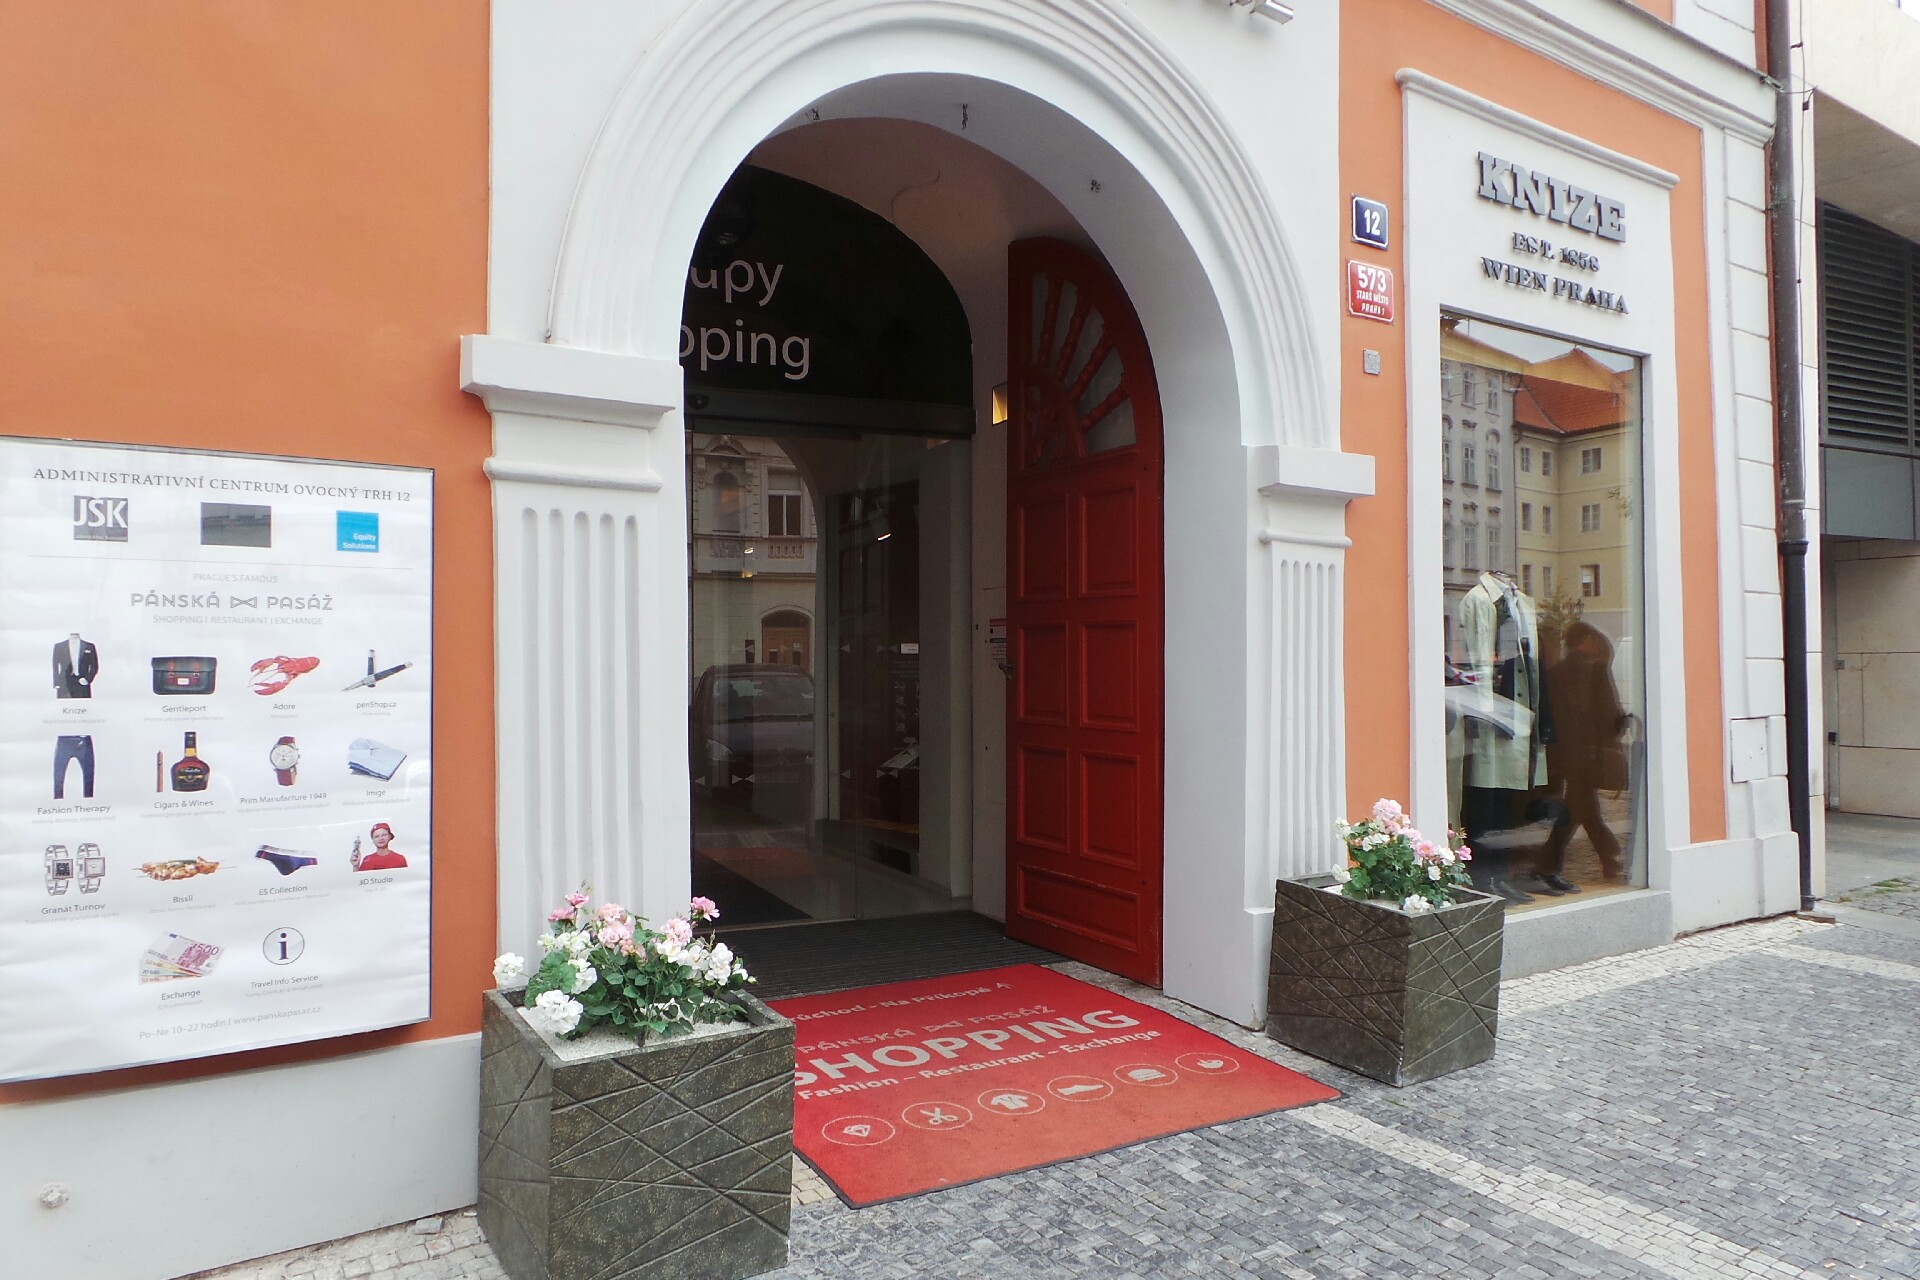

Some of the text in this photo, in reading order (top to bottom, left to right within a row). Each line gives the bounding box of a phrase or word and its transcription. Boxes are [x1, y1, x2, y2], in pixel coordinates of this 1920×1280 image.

[1477, 151, 1626, 243] KNIZE
[1363, 208, 1381, 236] 12
[1512, 231, 1600, 273] EST. 1858
[1357, 265, 1387, 293] 573
[1480, 256, 1629, 315] WIEN PRAHA
[1356, 289, 1389, 305] STARÉ MĚSTO
[1361, 302, 1381, 315] PRAHA
[33, 467, 411, 502] ADMINISTRATIVNÍ CENTRUM OVOCNÝ TRH 12
[74, 498, 128, 528] JSK
[353, 532, 376, 542] Equity
[342, 542, 376, 550] Solutions
[239, 574, 278, 583] FAMOUS
[130, 590, 333, 611] PÁNSKÁ PASÁŽ
[153, 615, 323, 625] SHOPPING RESTAURANT EXCHANGE
[62, 707, 87, 715] Knize
[162, 705, 207, 713] Gentleport
[273, 703, 296, 711] Adore
[356, 701, 397, 710] penShop.cz
[154, 801, 179, 810] Cigars
[189, 799, 214, 807] Wines
[260, 794, 307, 803] Manufacture
[37, 804, 111, 815] Fashion Therapy
[358, 876, 393, 886] 3D Studio
[259, 885, 308, 896] ES Collection
[41, 903, 106, 915] Granát Turnov
[197, 943, 220, 956] 500
[250, 974, 319, 988] Travel Info Service
[161, 988, 201, 1001] Exchange
[200, 1020, 226, 1031] hodin
[233, 1006, 322, 1026] www.panskapasaz.cz
[797, 1029, 1163, 1100] Fashion Restaurant Exchange
